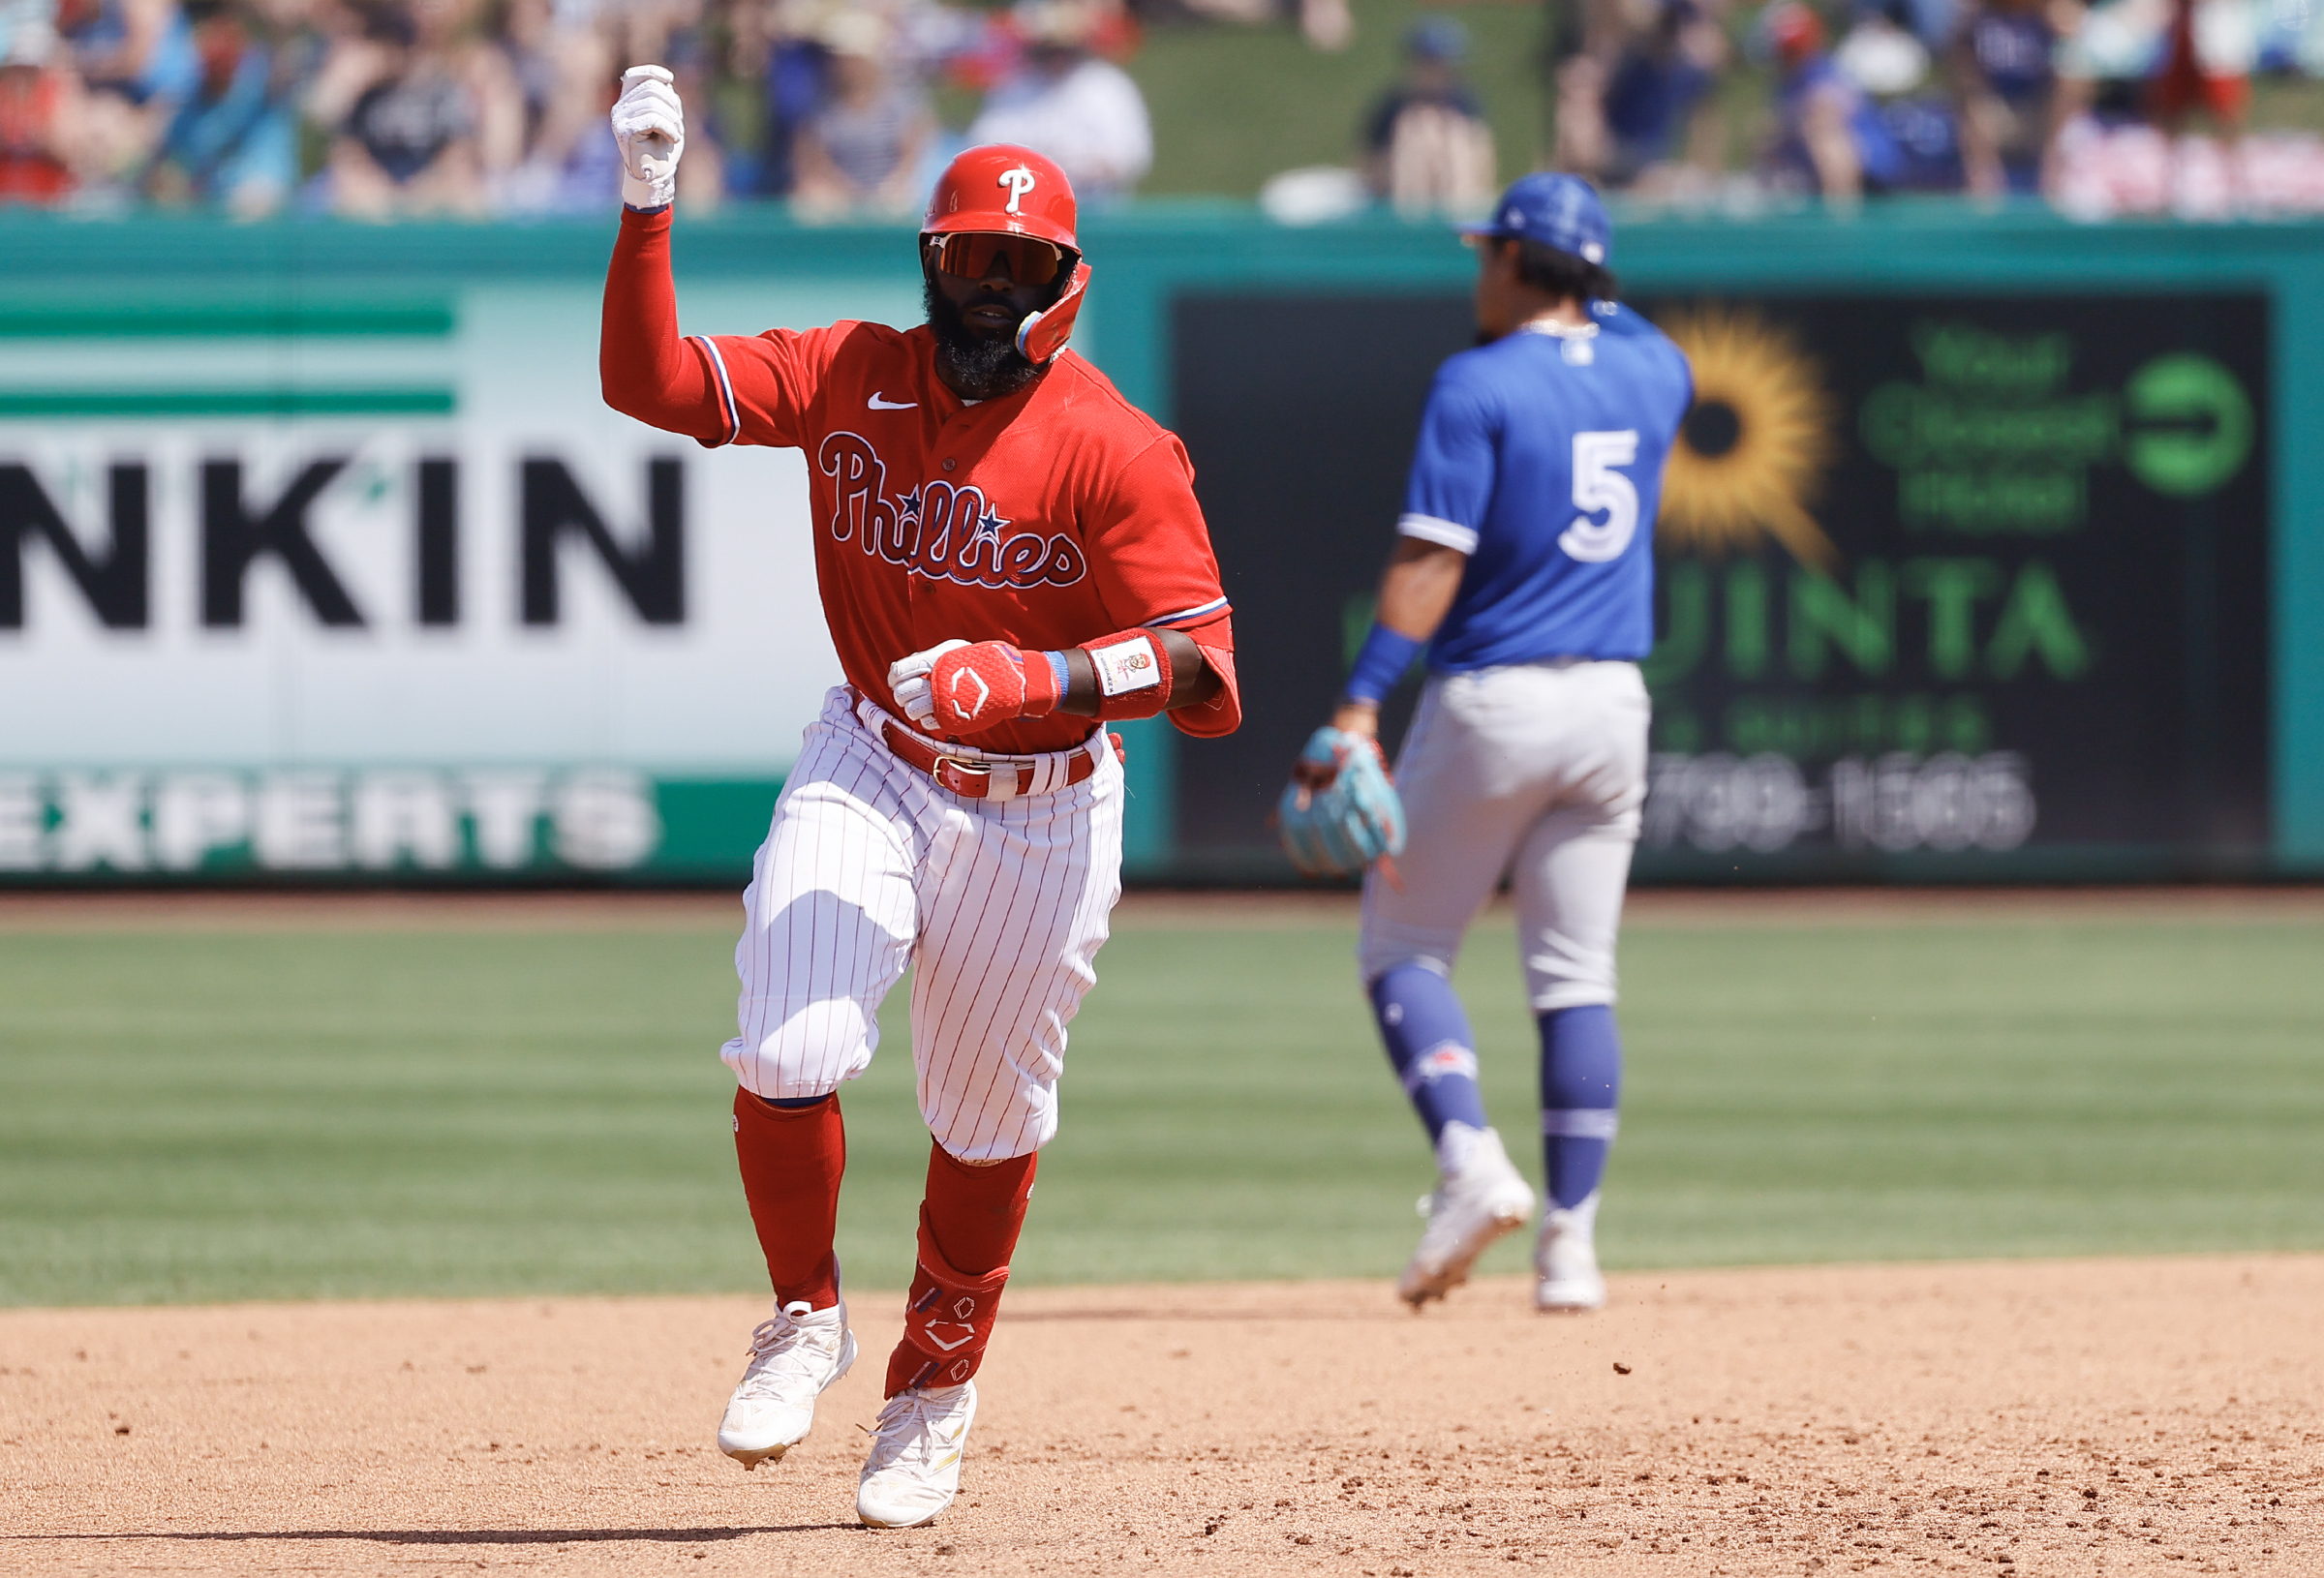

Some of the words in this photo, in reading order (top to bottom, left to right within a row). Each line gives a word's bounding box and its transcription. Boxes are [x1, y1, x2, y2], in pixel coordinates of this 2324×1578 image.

[998, 167, 1036, 214] P
[0, 455, 689, 629] NKIN
[819, 431, 1086, 589] Phillies
[1557, 428, 1640, 563] 5
